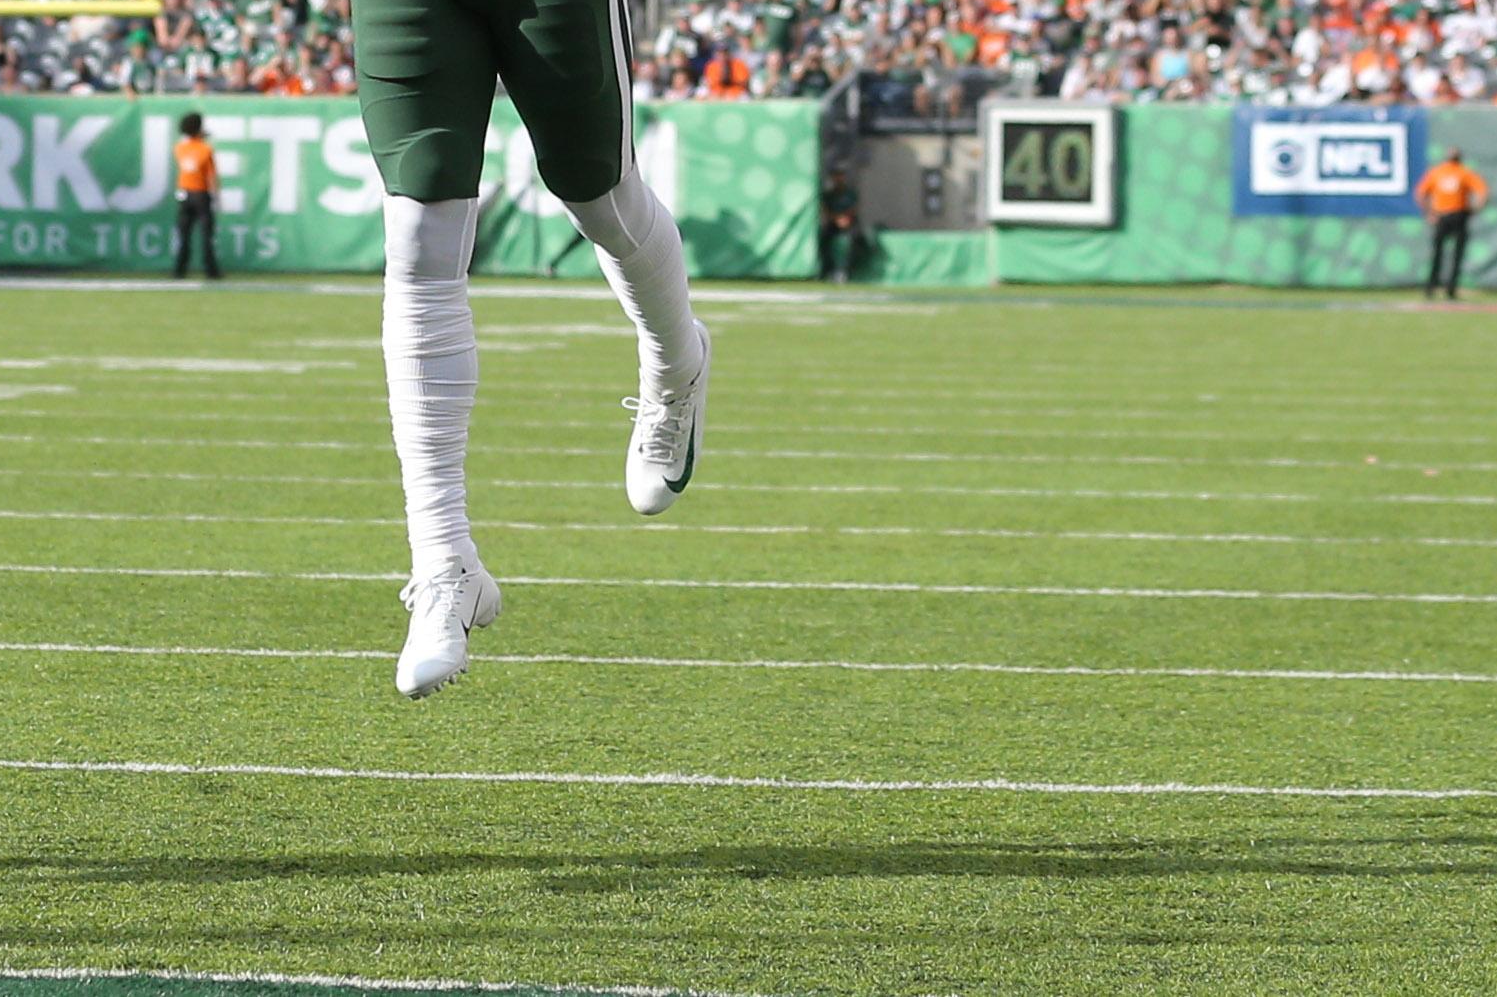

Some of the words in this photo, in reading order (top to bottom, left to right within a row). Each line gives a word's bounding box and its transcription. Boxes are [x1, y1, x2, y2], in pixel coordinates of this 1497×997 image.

[1004, 130, 1092, 199] 40
[1321, 142, 1391, 177] NFL
[91, 222, 281, 259] TICTS
